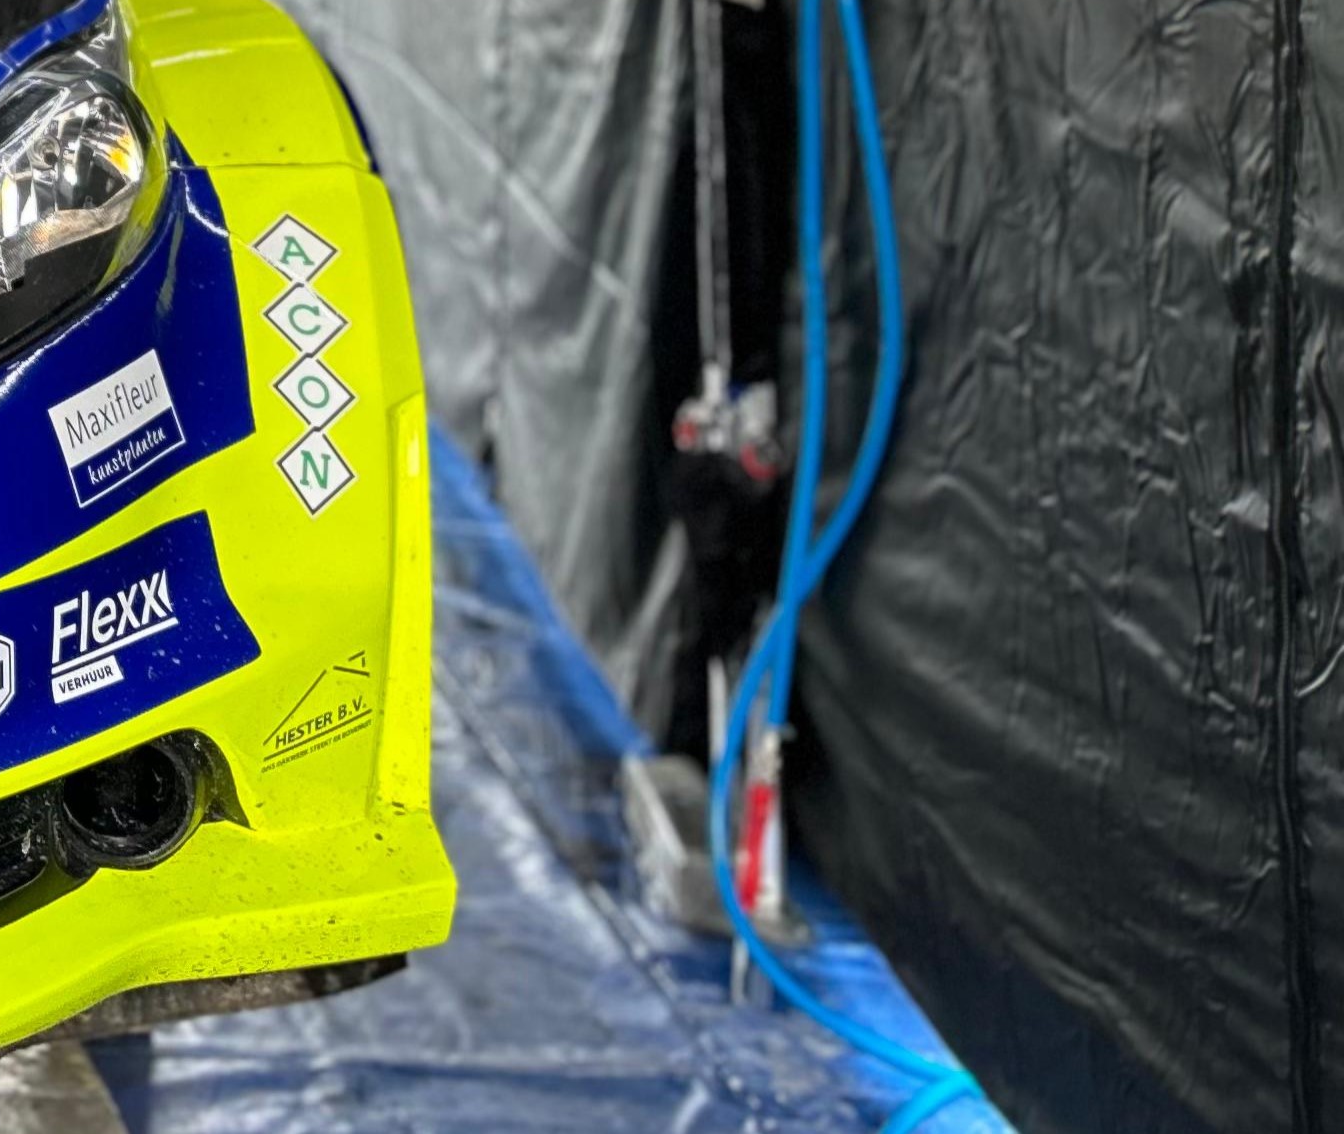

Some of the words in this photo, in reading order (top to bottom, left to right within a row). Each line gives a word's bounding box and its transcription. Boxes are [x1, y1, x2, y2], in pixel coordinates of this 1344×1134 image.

[64, 372, 160, 449] Maxifleur
[87, 426, 167, 486] kunstplanten
[58, 664, 115, 695] VERHUUR
[275, 711, 334, 750] HESTER
[337, 694, 367, 721] B.V.
